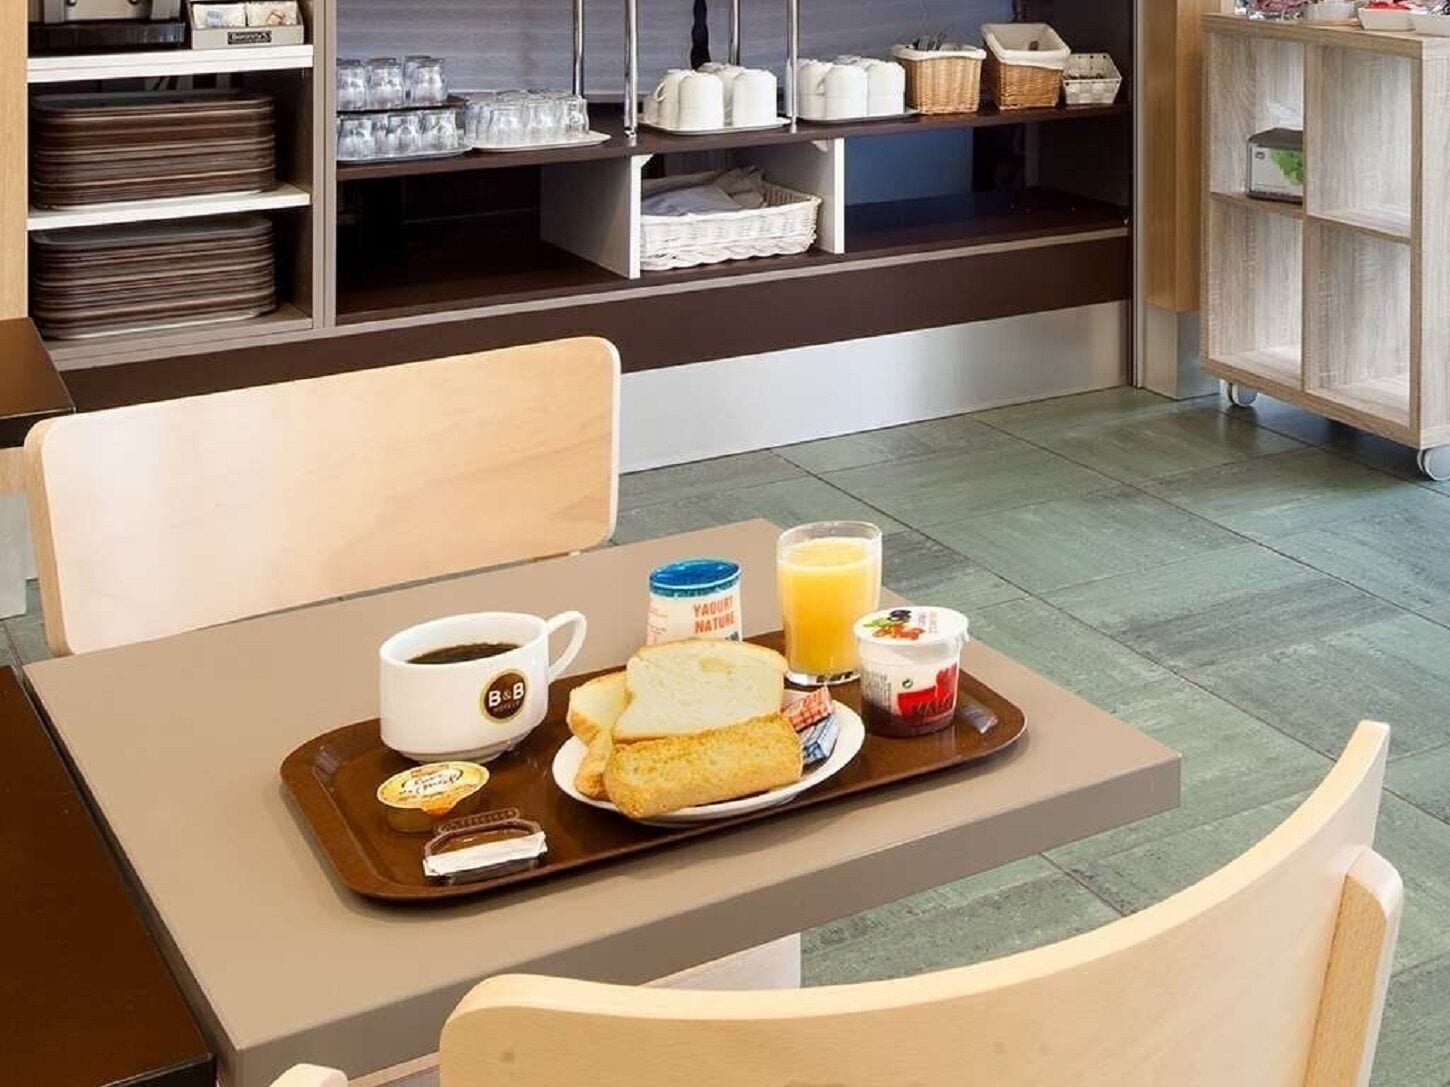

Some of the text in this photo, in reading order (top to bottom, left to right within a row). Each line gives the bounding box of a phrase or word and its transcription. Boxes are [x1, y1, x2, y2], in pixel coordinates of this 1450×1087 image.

[693, 595, 734, 618] YAOURT
[694, 611, 735, 634] NATURE
[488, 681, 525, 708] B&B
